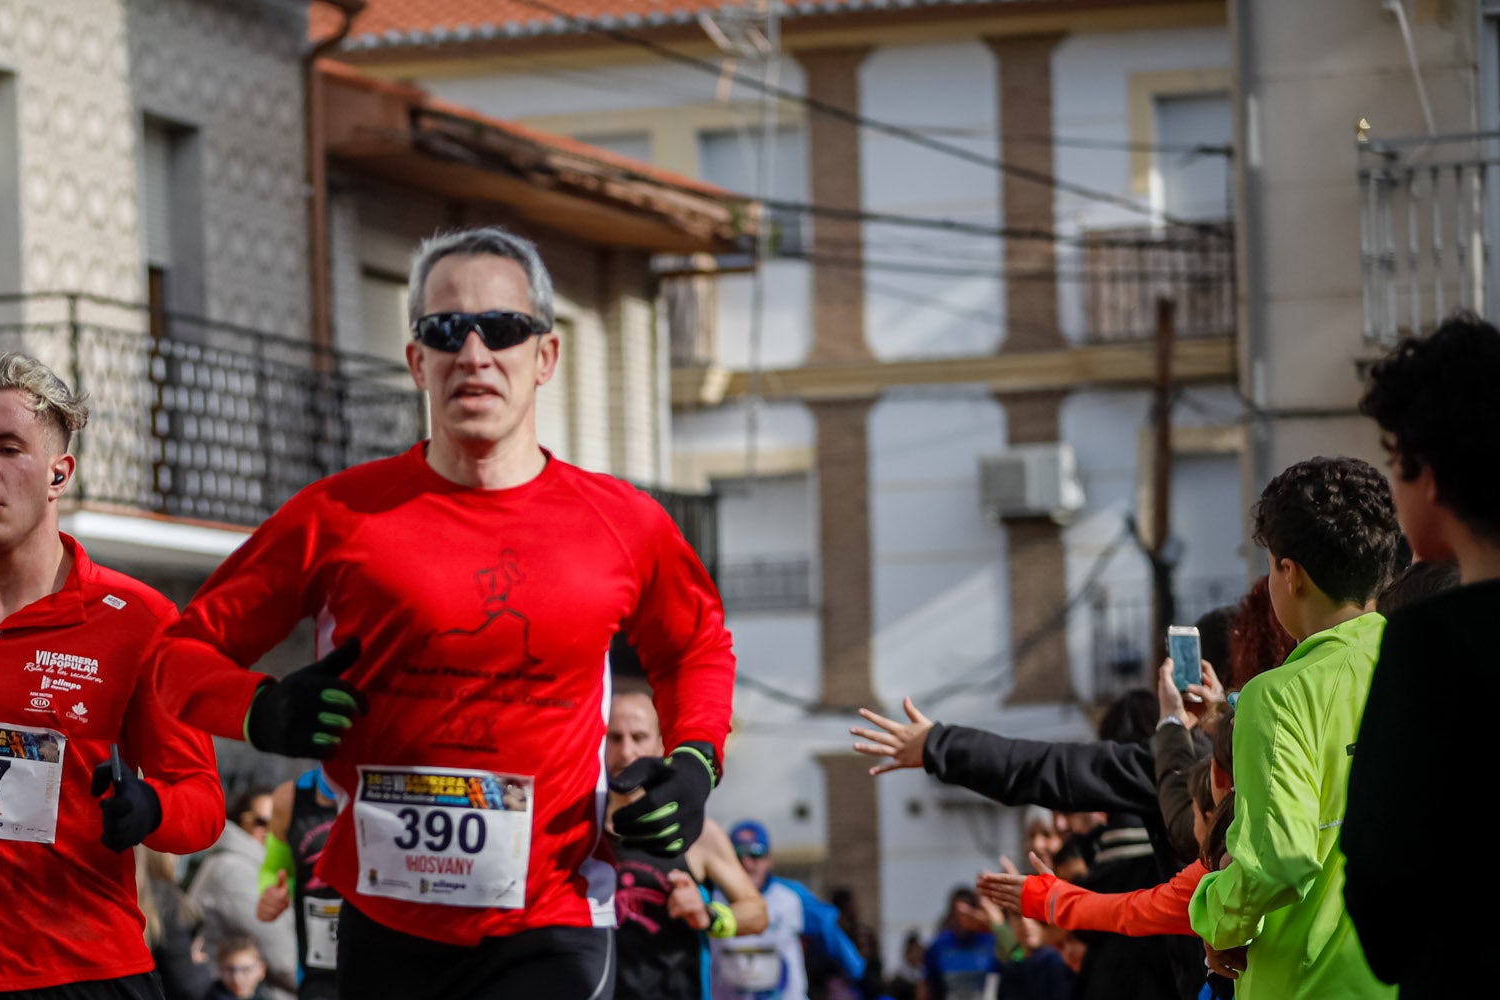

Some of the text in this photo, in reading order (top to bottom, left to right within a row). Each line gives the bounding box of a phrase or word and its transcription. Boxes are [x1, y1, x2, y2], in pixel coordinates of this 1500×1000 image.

[36, 650, 51, 666] VII
[51, 653, 98, 668] CARRERA
[50, 659, 98, 675] POPULAR
[52, 678, 81, 690] olimpo
[394, 807, 486, 854] 390
